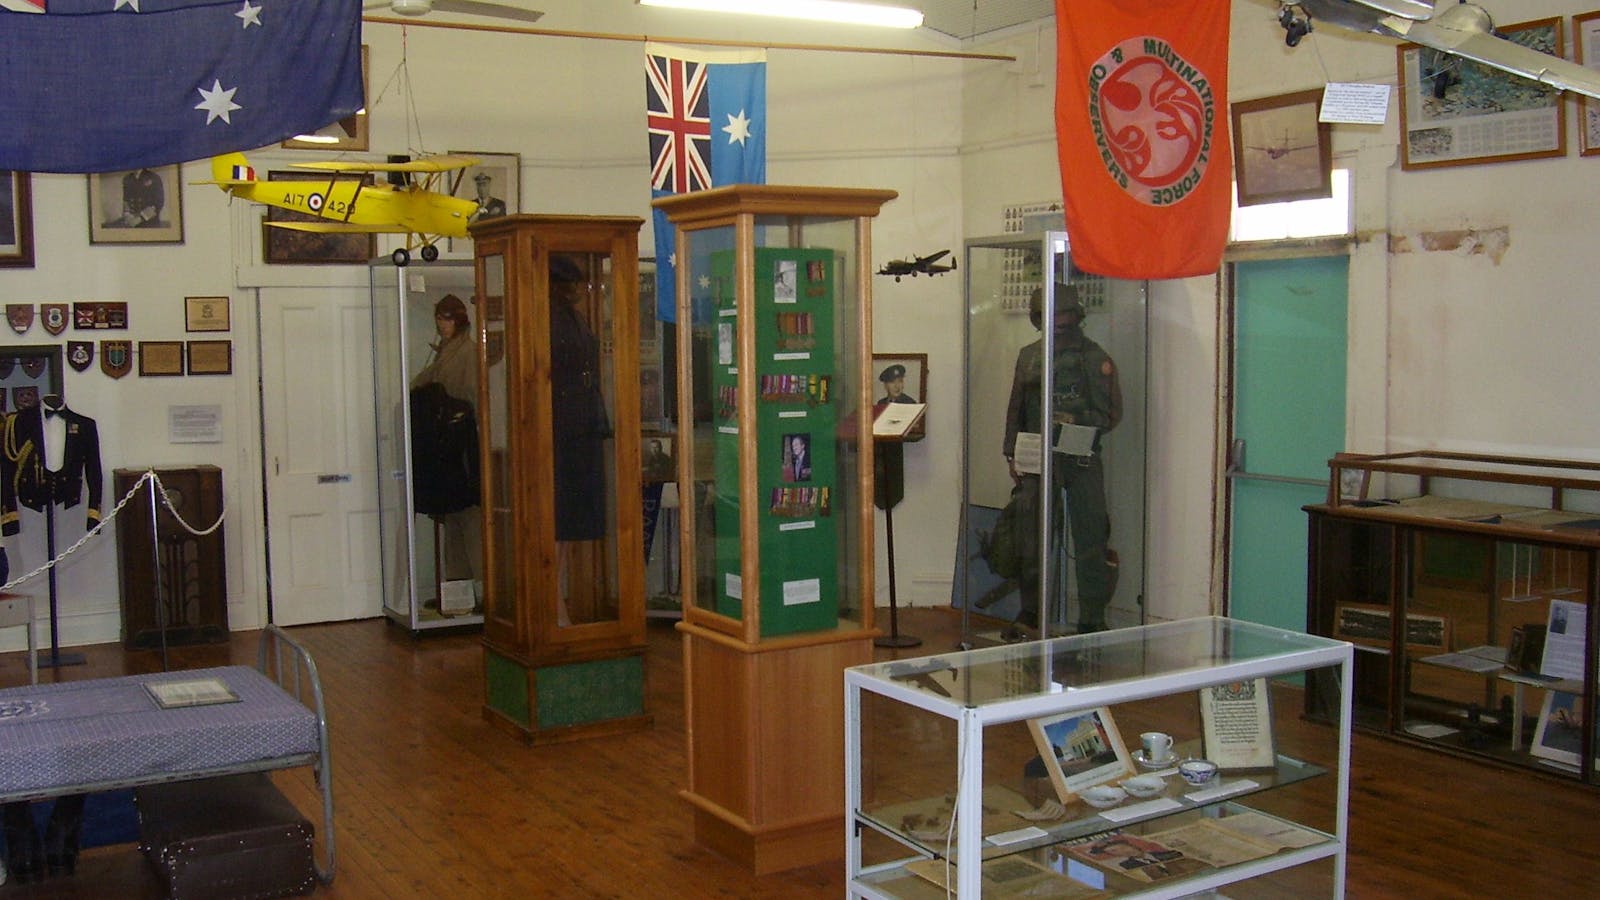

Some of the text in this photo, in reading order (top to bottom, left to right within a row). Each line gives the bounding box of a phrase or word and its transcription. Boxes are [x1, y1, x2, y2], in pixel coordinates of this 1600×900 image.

[1088, 64, 1129, 189] OBSERVERS
[1143, 38, 1214, 205] MULTINATIONAL FORCE
[283, 193, 305, 207] A17
